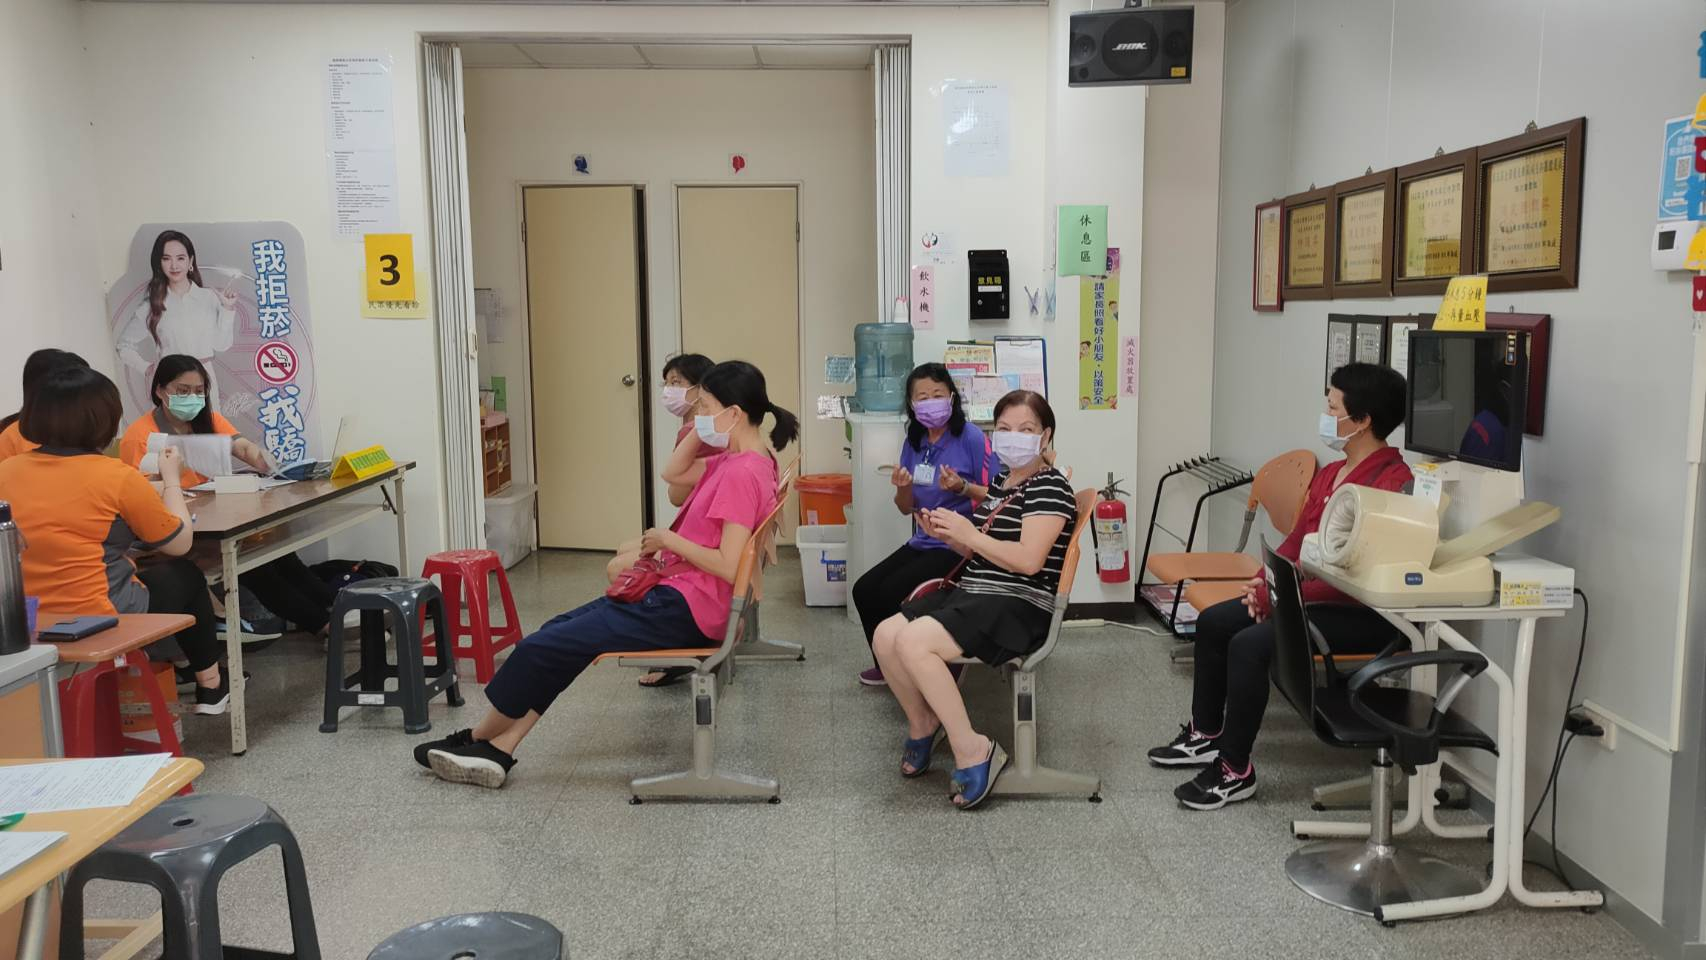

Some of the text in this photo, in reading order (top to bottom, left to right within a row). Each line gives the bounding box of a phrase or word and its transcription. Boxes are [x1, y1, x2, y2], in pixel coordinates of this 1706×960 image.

[1079, 214, 1092, 262] 休息區
[252, 240, 292, 338] 我拒菸
[380, 254, 400, 286] 3
[919, 270, 930, 313] 飲水機
[258, 383, 305, 464] 我驕
